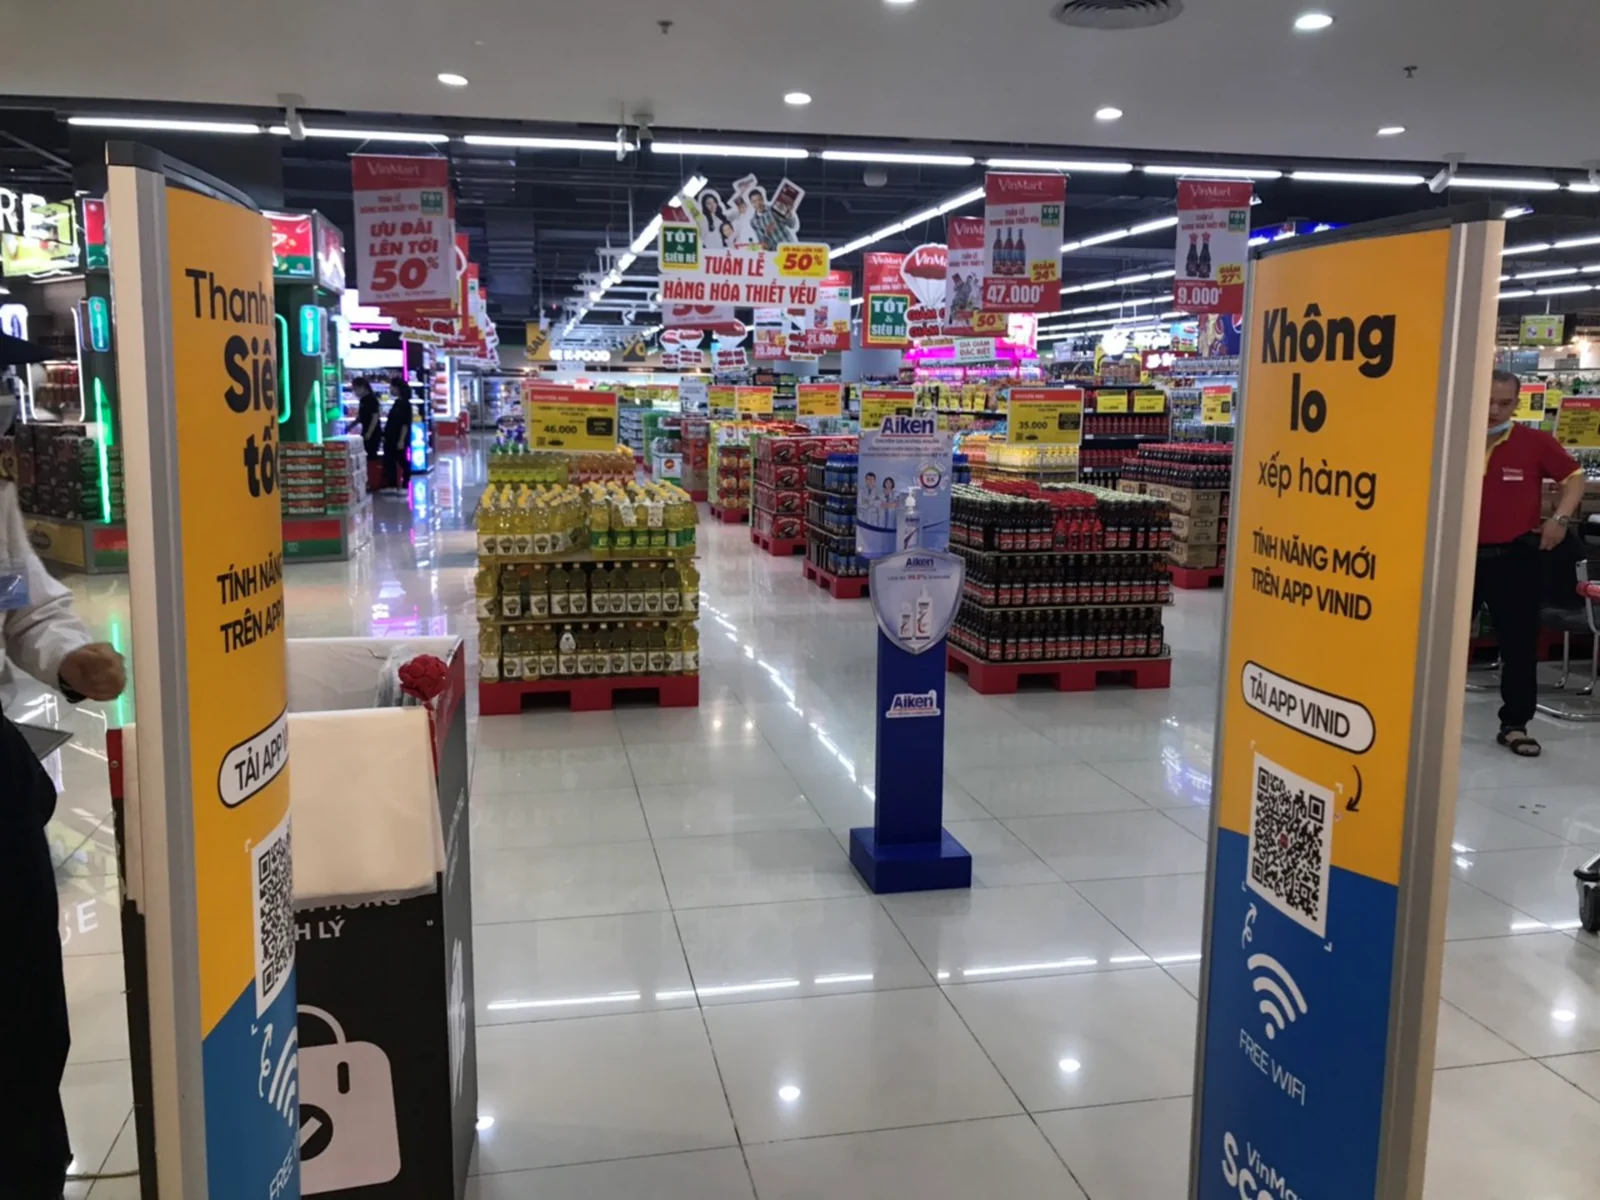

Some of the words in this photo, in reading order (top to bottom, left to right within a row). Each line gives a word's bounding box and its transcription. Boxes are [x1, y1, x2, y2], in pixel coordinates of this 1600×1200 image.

[998, 178, 1043, 192] VinMart
[1190, 184, 1231, 197] VinMart
[369, 238, 403, 257] LÊN
[408, 237, 439, 254] TỚI
[664, 229, 696, 243] TỐT
[664, 251, 684, 262] SIÊU
[685, 252, 697, 263] RẺ
[705, 250, 743, 275] TUẦN
[747, 253, 765, 276] LỄ
[783, 253, 823, 271] 50%
[370, 257, 439, 291] 50%
[185, 268, 269, 326] Thanh
[663, 277, 705, 300] HÀNG
[709, 280, 740, 302] HÓA
[745, 278, 785, 303] THIẾT
[789, 279, 817, 304] YẾU
[872, 298, 906, 314] TỐT
[871, 323, 893, 336] SIÊU
[1261, 303, 1396, 379] Không
[224, 335, 277, 414] Siê
[1290, 373, 1327, 433] lo
[543, 425, 578, 434] 46.000
[881, 417, 935, 434] Aiken
[244, 415, 281, 498] tố
[1258, 450, 1292, 498] xếp
[1299, 458, 1377, 511] hàng
[905, 557, 934, 568] Aiken
[1252, 527, 1279, 561] TÍNH
[1280, 536, 1328, 571] NĂNG
[1332, 545, 1376, 581] MỚI
[217, 563, 257, 604] TÍNH
[259, 554, 283, 592] NĂN
[1251, 567, 1280, 601] TRÊN
[1281, 577, 1313, 607] APP
[1317, 589, 1373, 621] VINID
[220, 608, 263, 653] TRÊN
[893, 694, 934, 709] Aiken
[1250, 673, 1268, 705] TẢI
[1268, 688, 1298, 717] APP
[1300, 698, 1350, 739] VINID
[235, 747, 260, 790] TẢI
[263, 740, 283, 776] APP
[318, 915, 345, 939] LÝ
[1239, 1029, 1270, 1076] FREE
[1271, 1059, 1306, 1106] WIFI
[1246, 1140, 1303, 1200] VinMa
